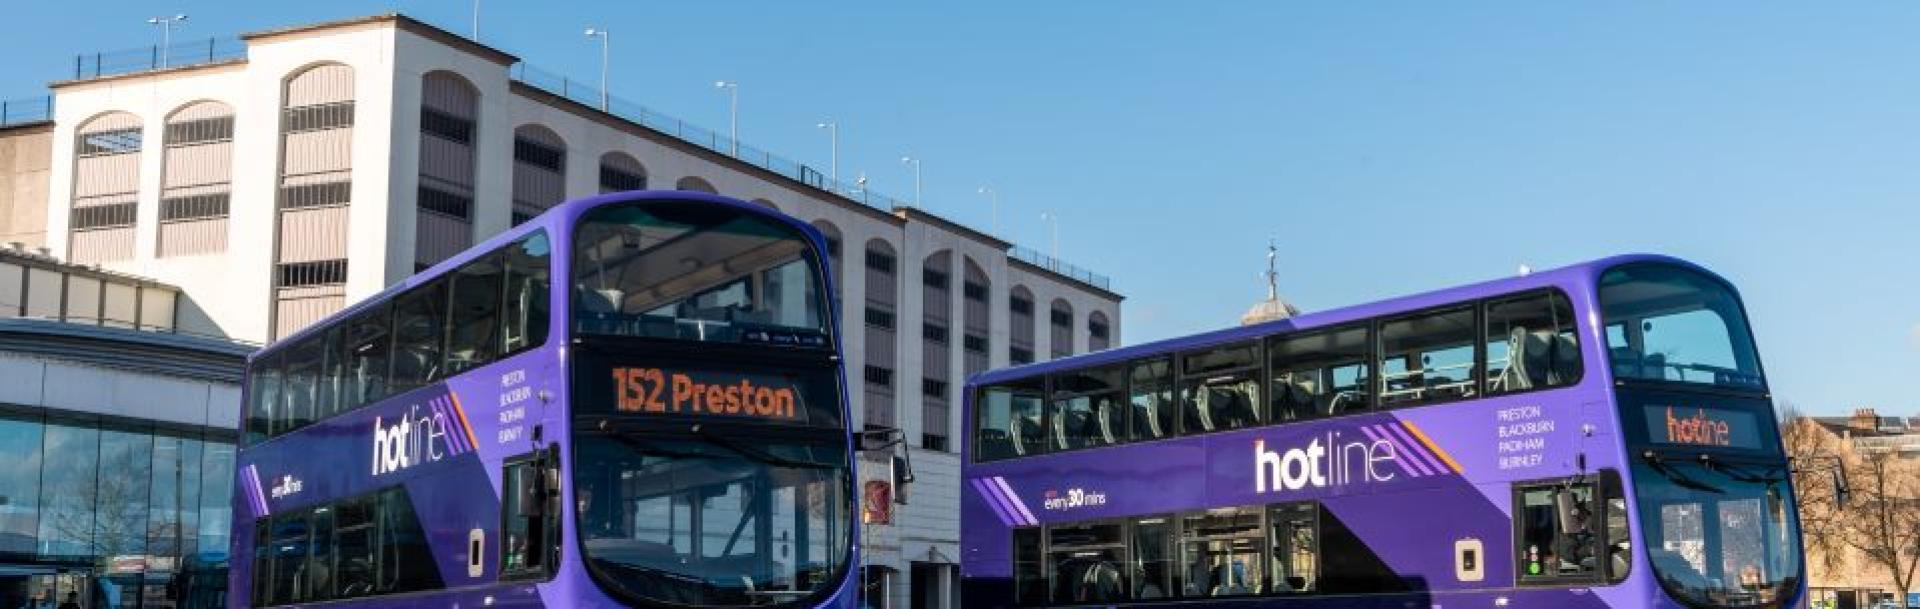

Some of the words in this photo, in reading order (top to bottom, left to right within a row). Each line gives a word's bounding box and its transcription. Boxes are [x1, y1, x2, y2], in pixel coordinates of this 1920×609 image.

[612, 367, 666, 412] 152
[671, 373, 795, 418] Preston
[1499, 405, 1540, 421] PRESTON
[372, 404, 445, 475] hotline
[1499, 420, 1554, 438] BLACKBURN
[1666, 405, 1729, 446] hotline
[1255, 431, 1395, 493] hotline
[1044, 498, 1067, 511] every
[1068, 488, 1083, 507] 30
[1084, 490, 1106, 506] mins
